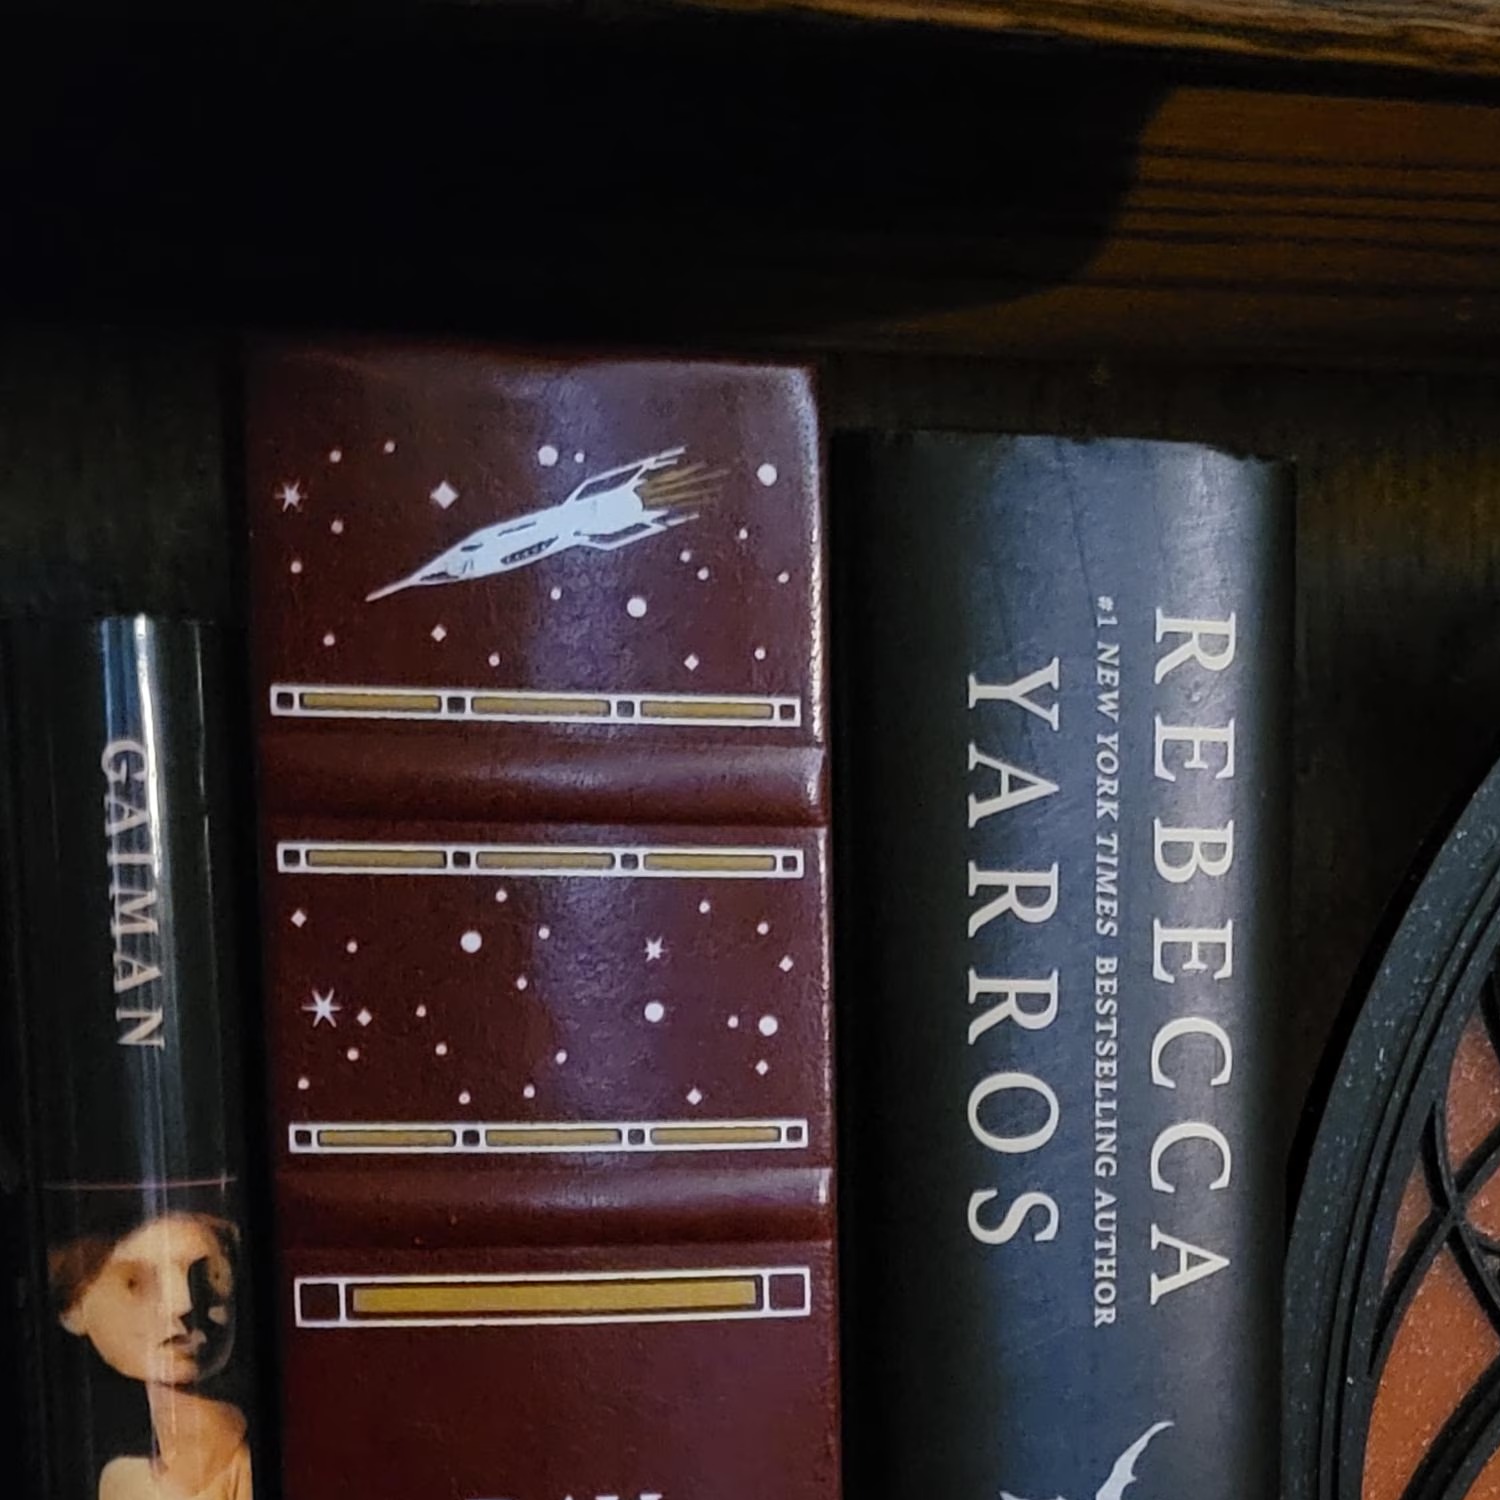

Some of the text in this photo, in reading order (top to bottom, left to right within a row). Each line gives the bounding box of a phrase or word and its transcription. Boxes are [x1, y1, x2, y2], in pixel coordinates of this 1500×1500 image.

[102, 739, 165, 1050] GAIMAN
[967, 657, 1060, 1245] YARROS
[1094, 595, 1120, 1328] #1 NEW YORK TIMES BESTSELLING AUTHOR
[1150, 607, 1237, 1306] REBECCA
